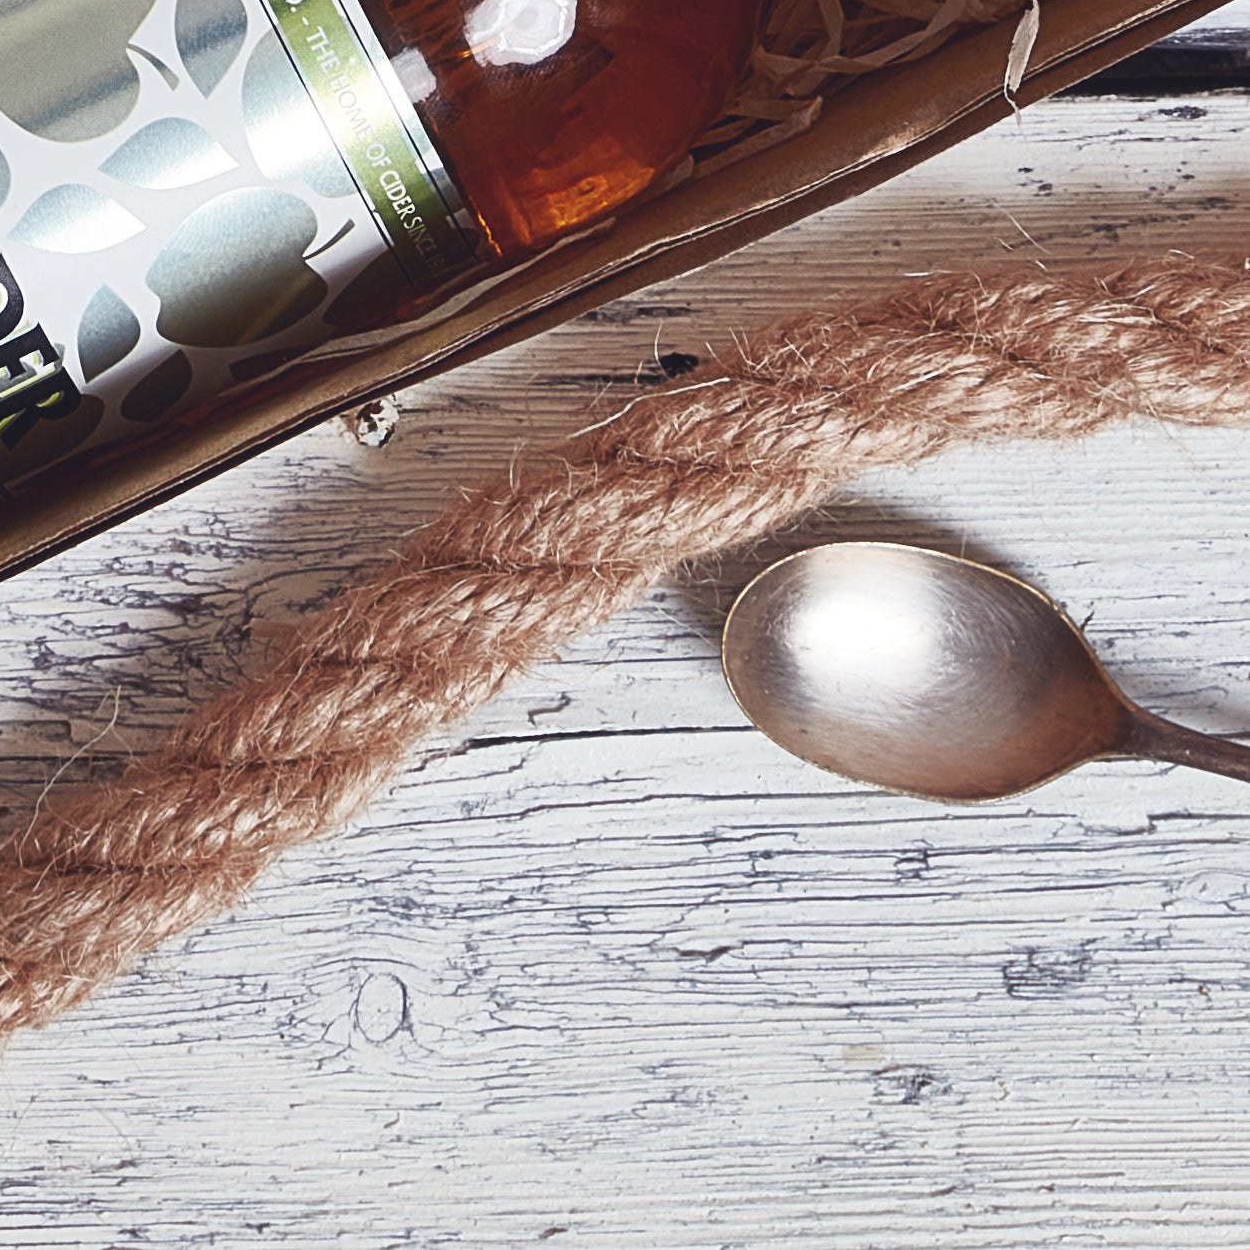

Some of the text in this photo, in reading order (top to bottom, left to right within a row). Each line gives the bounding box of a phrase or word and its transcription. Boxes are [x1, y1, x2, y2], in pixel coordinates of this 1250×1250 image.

[306, 26, 341, 75] THE
[330, 72, 378, 145] HOME
[365, 142, 392, 168] OF
[379, 170, 415, 222] CIDER
[403, 215, 440, 257] SINCE
